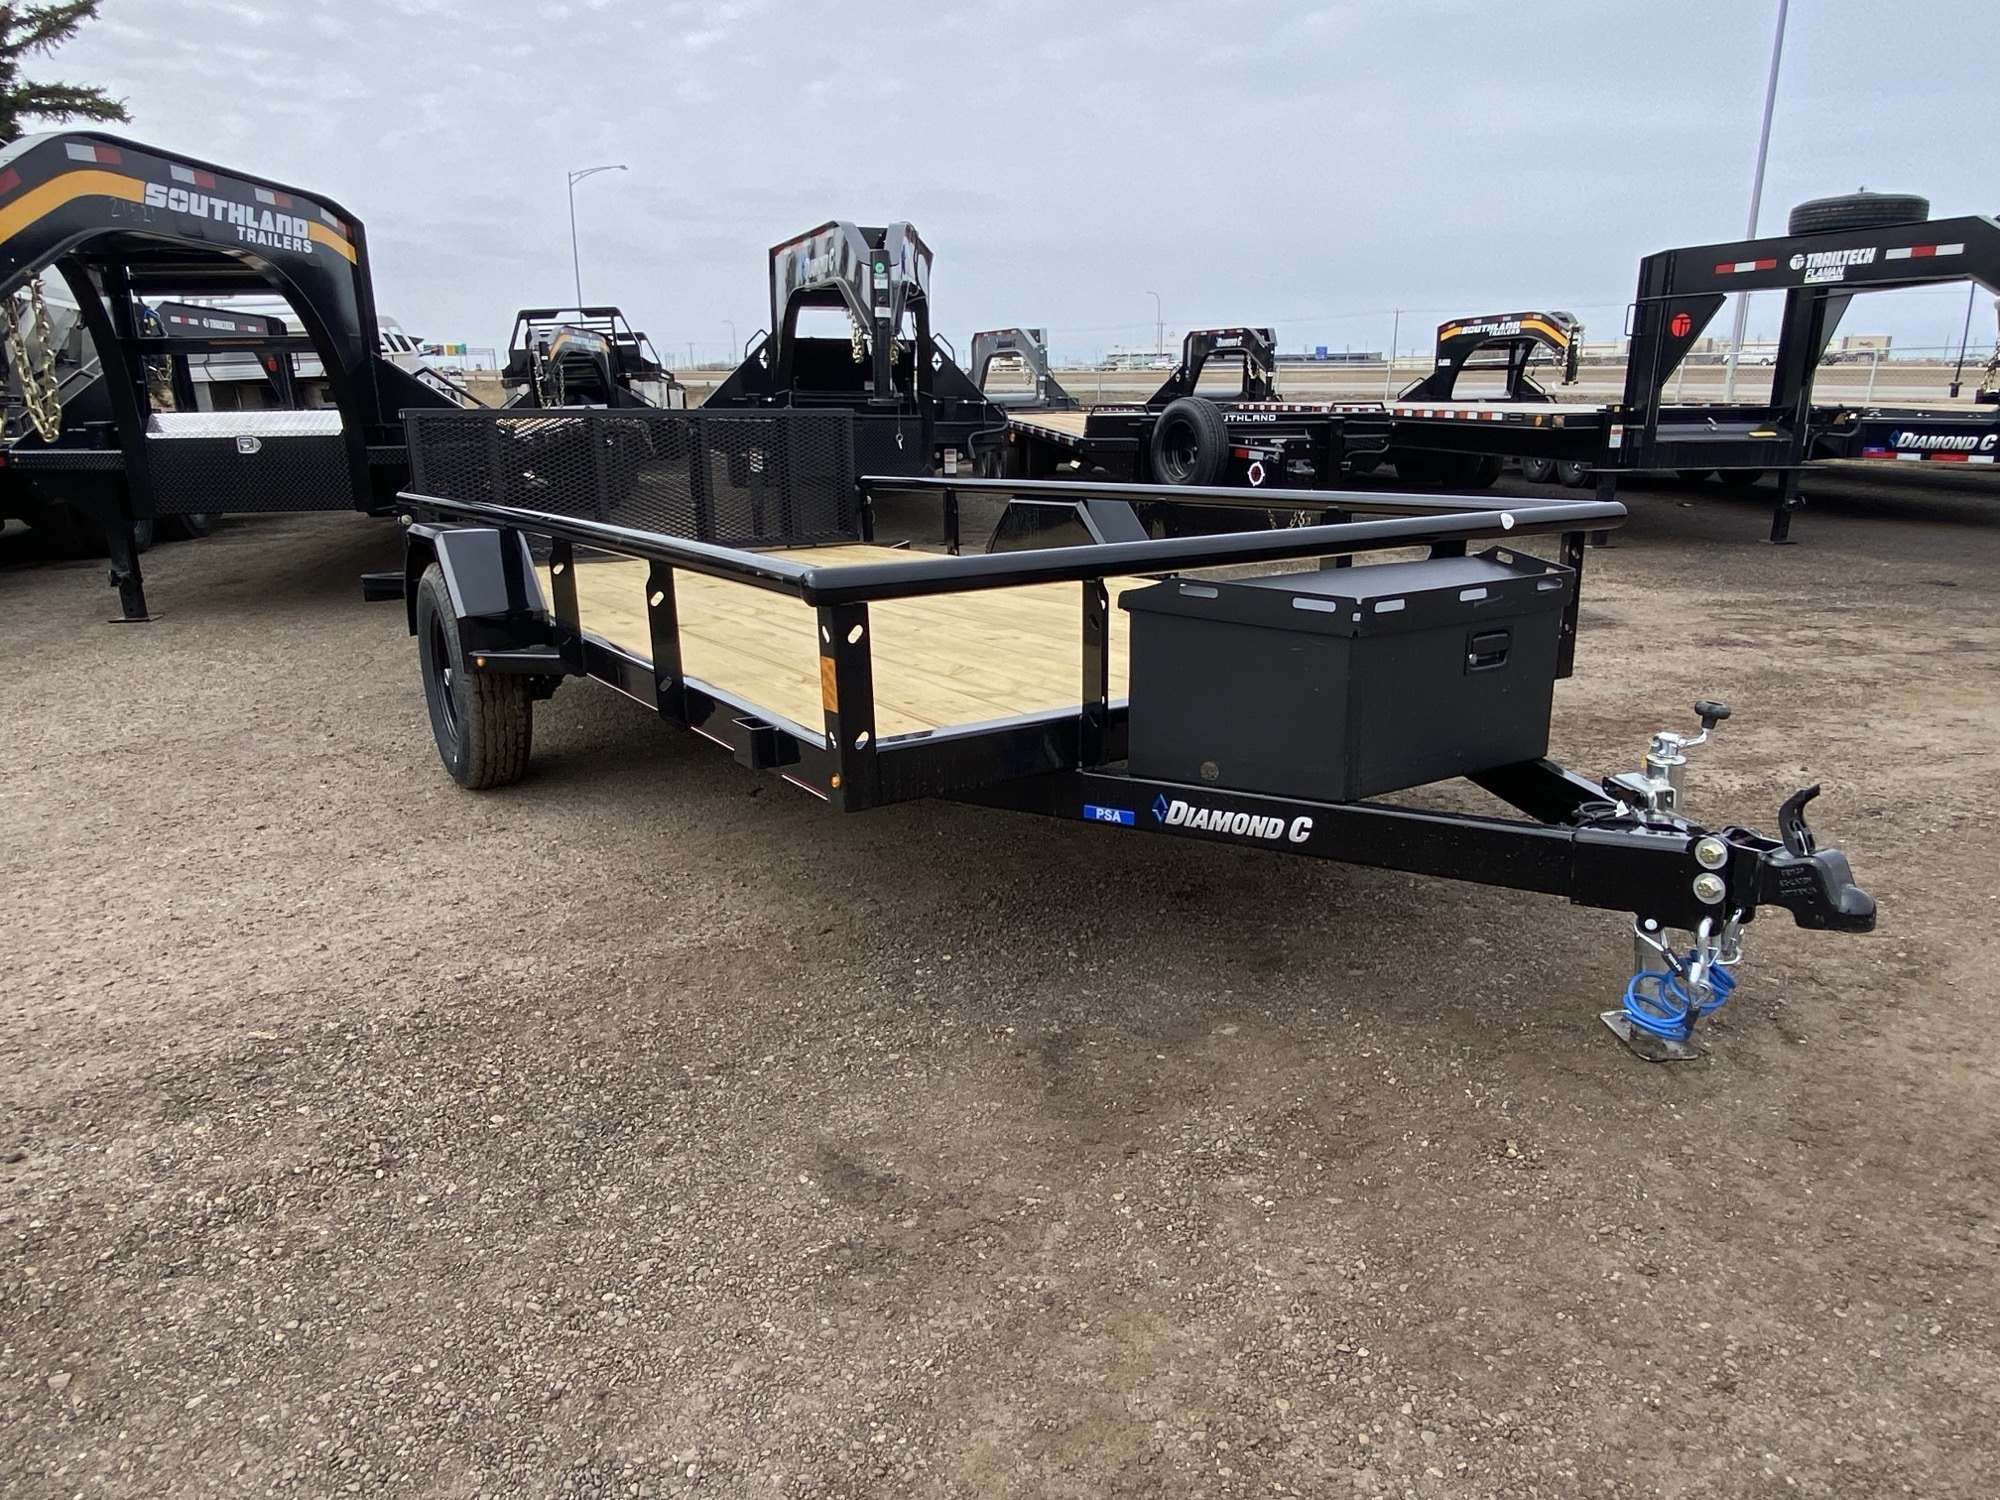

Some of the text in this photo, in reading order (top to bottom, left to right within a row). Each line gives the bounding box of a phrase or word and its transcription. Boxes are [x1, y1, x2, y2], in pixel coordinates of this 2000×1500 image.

[145, 182, 310, 239] SOUTHLAND
[237, 226, 313, 254] TRAILERS
[1806, 247, 1877, 269] TRAILTECH
[1462, 321, 1521, 334] SOUTHLAND
[1224, 414, 1276, 422] UTHLAND
[1896, 432, 1998, 451] DIAMOND C
[1096, 807, 1121, 823] PSA
[1165, 800, 1313, 843] DIAMOND C
